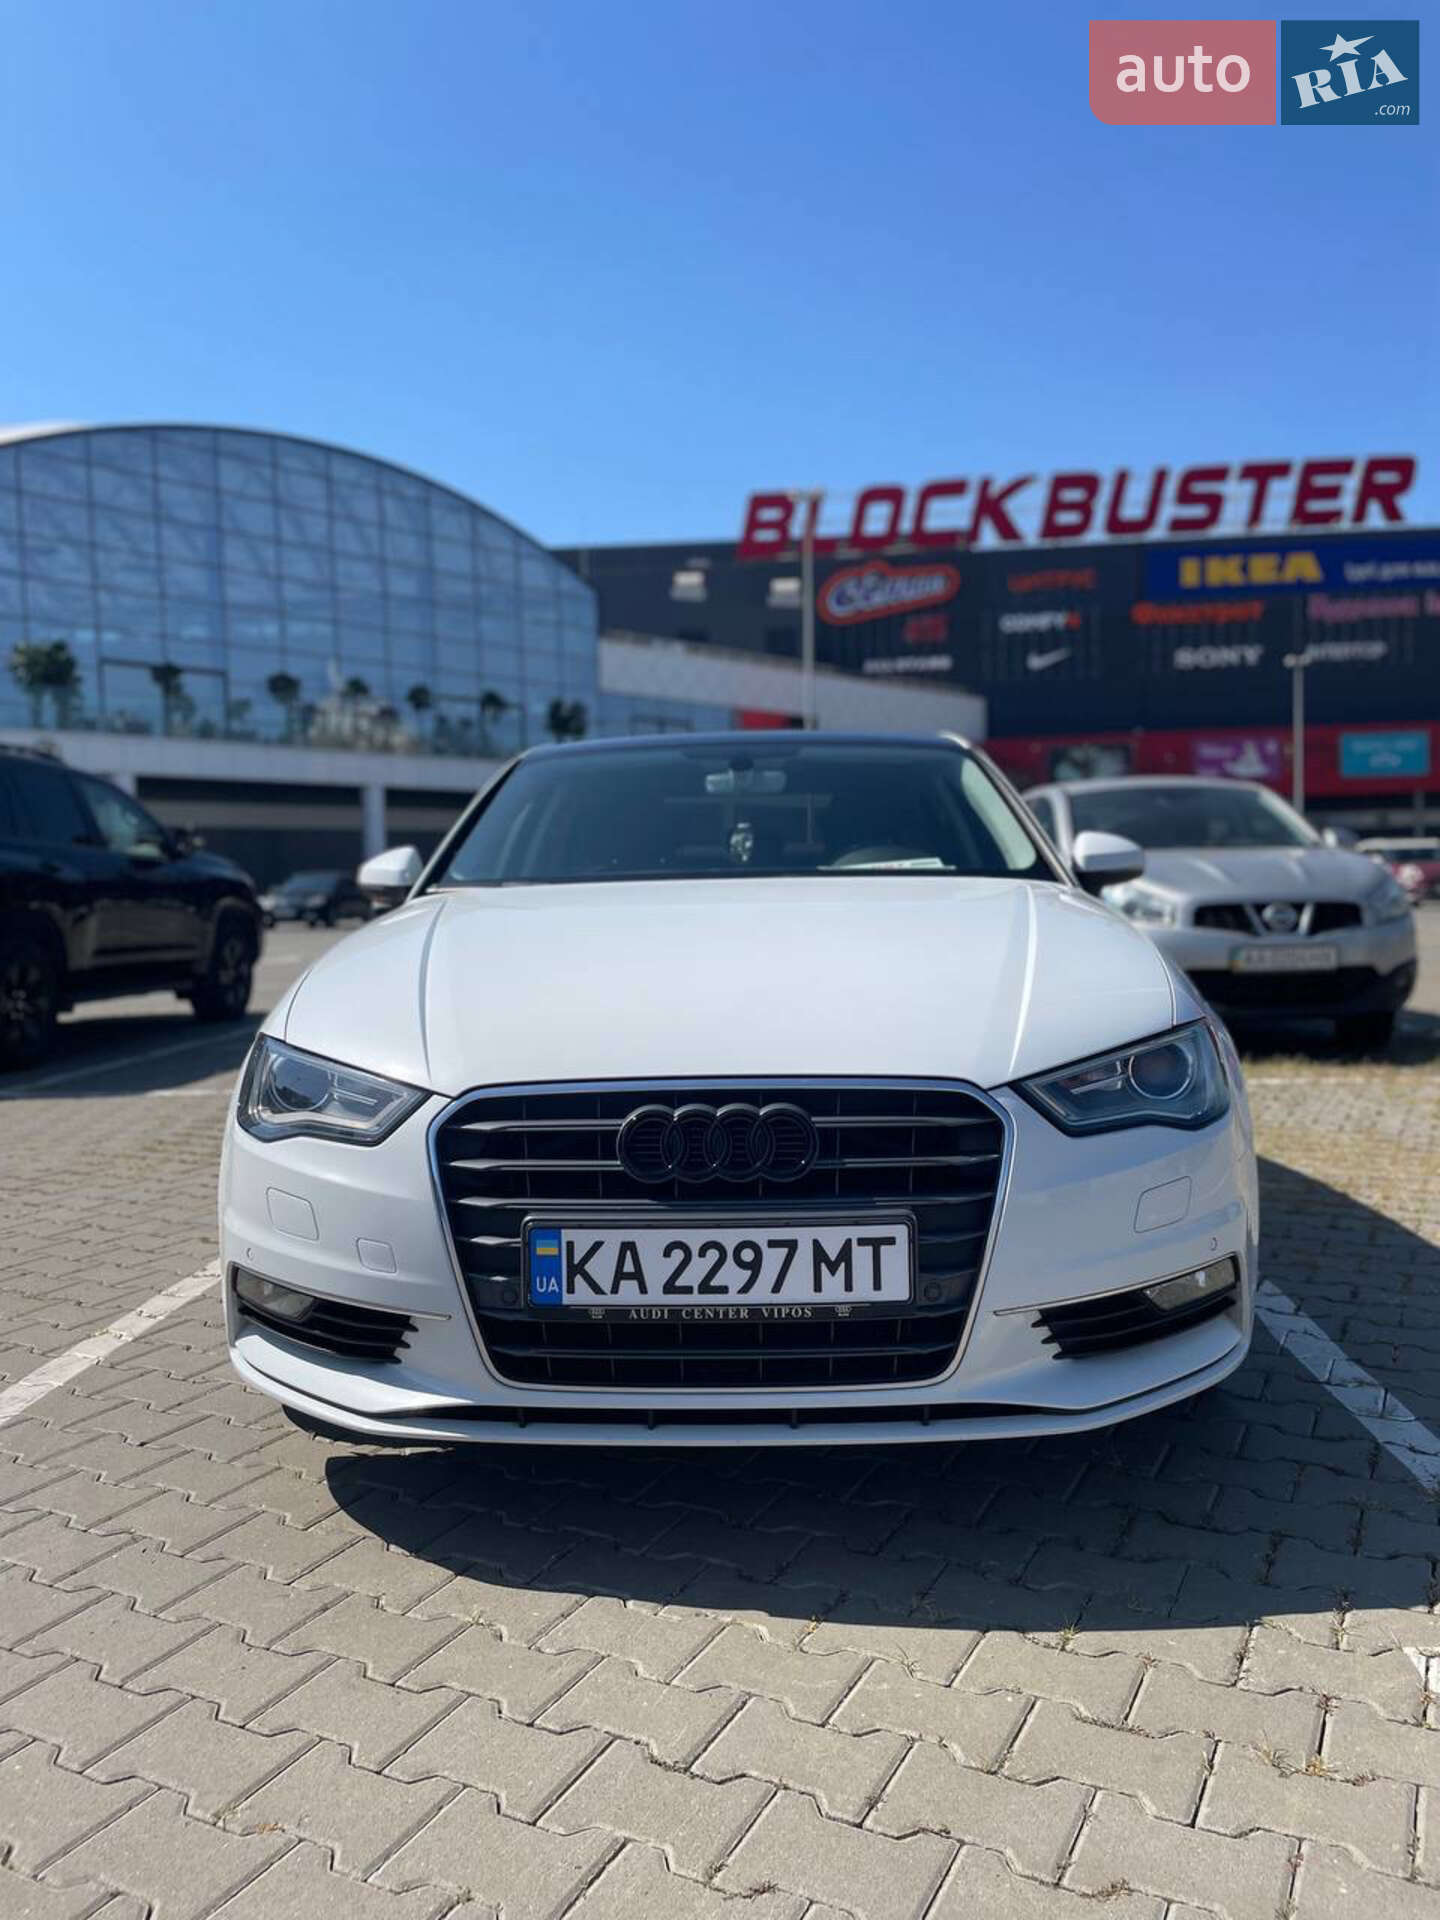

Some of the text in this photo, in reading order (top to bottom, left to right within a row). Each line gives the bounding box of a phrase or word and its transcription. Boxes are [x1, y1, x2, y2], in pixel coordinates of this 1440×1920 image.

[737, 457, 1416, 559] BLOCKBUSTER
[1178, 551, 1324, 588] IKEA
[1173, 645, 1264, 669] SONY
[565, 1236, 897, 1296] KA 2297 MT
[536, 1277, 559, 1293] UA
[628, 1306, 814, 1320] AUDI CENTER VIPOS
